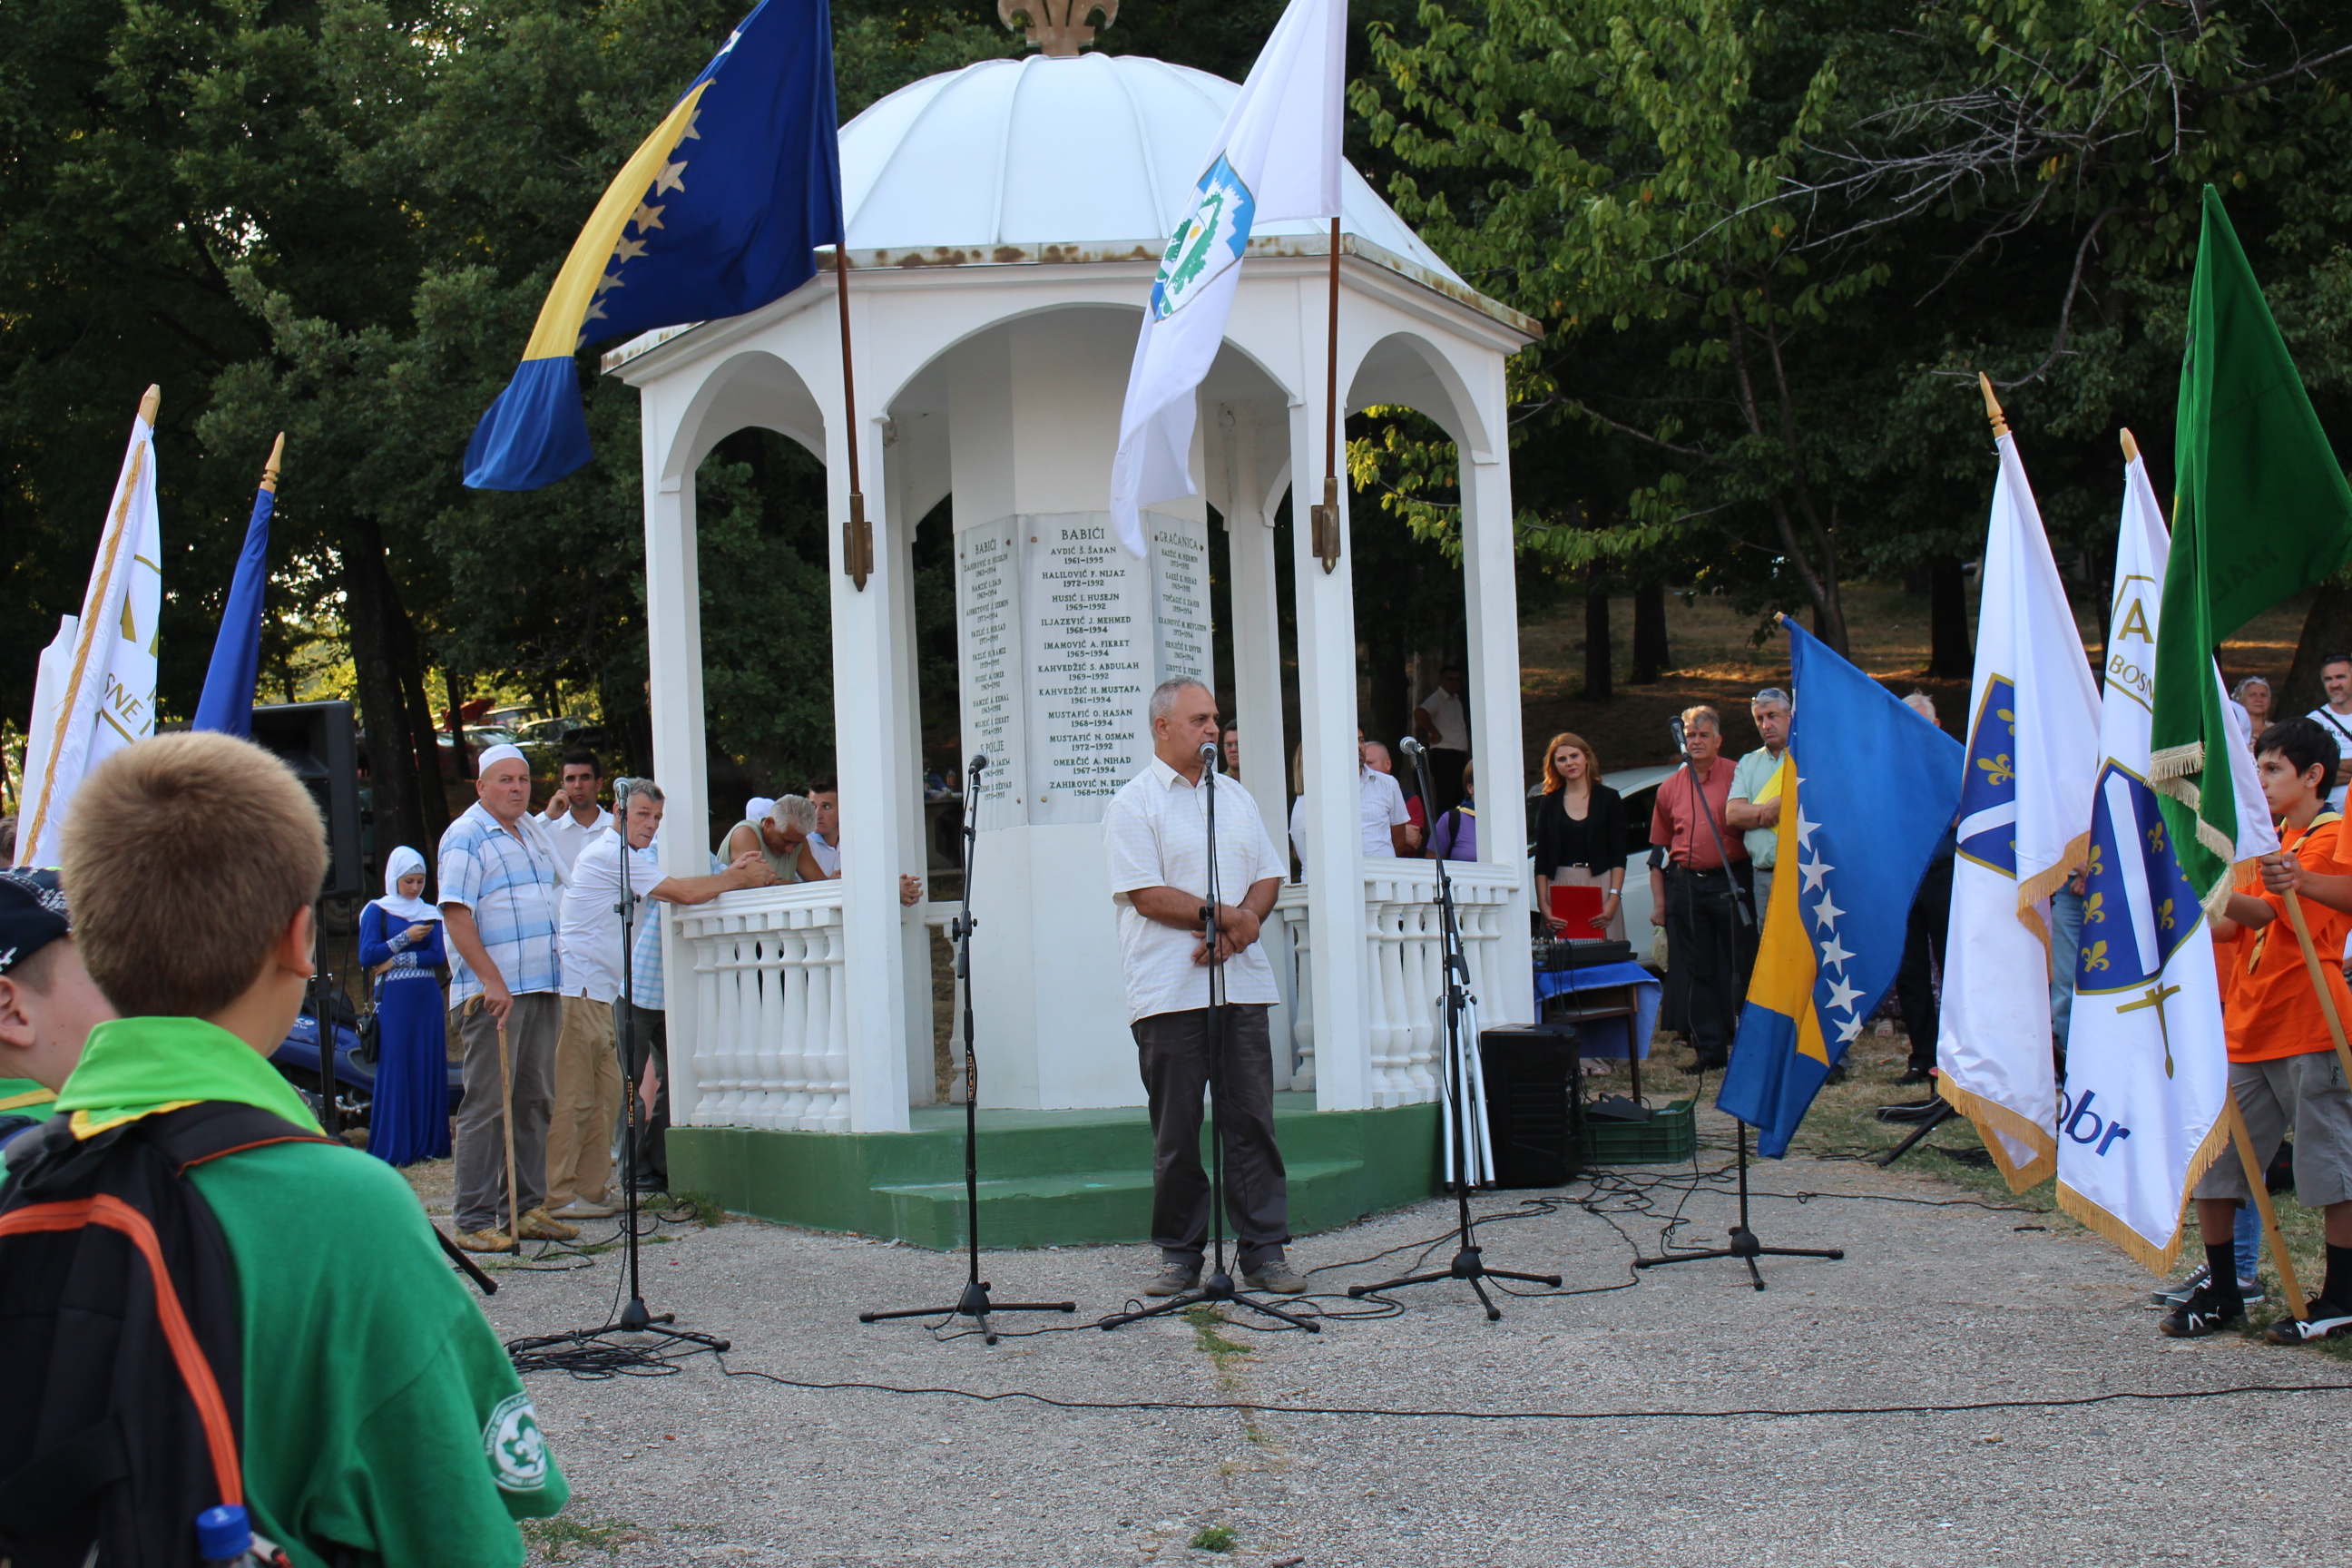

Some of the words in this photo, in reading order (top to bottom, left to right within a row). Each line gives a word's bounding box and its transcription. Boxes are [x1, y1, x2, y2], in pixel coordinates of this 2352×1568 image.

[1062, 526, 1104, 540] BABIĆI
[975, 538, 996, 554] BABIĆI
[1160, 531, 1198, 551] GRAČANICA
[1051, 546, 1076, 555] AVDIĆ
[1088, 545, 1116, 554] ŠABAN
[1043, 569, 1087, 579] HALILOVIĆ
[1052, 593, 1077, 603] HUSIĆ
[1087, 593, 1120, 602] HUSEJN
[1041, 616, 1085, 626] ILJAZEVIĆ
[1097, 616, 1132, 624] MEHMED
[1044, 640, 1086, 650] IMAMOVIĆ
[1101, 640, 1130, 648] FIKRET
[1038, 662, 1086, 672] KAHVEDŽIĆ
[1099, 662, 1139, 671] ABDULAH
[1039, 685, 1087, 696] KAHVEDŽIĆ
[1101, 685, 1141, 693] MUSTAFA
[1048, 709, 1090, 719] MUSTAFIĆ
[1102, 709, 1132, 717] HASAN
[1050, 732, 1091, 742] MUSTAFIĆ
[1105, 732, 1134, 740] OSMAN
[1054, 757, 1089, 767] OMERČIĆ
[1103, 757, 1132, 765] NIHAD
[1050, 779, 1097, 789] ZAHIROVIĆ
